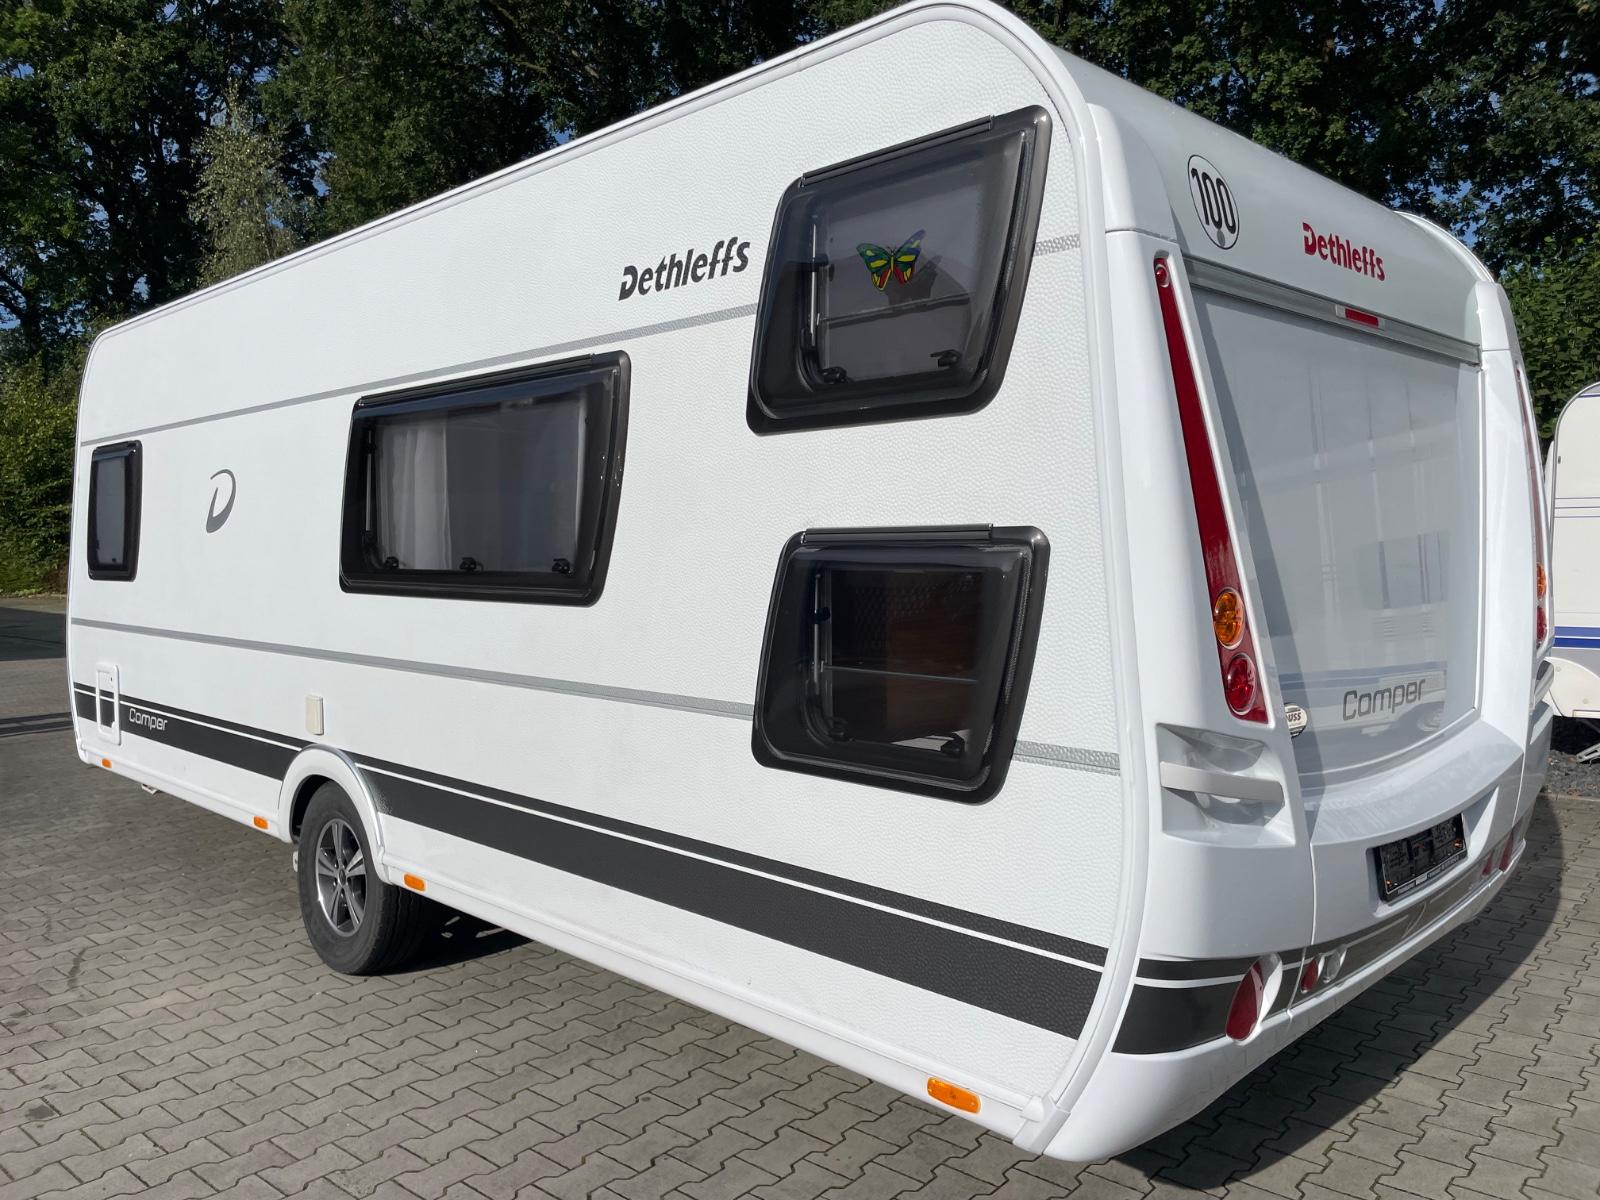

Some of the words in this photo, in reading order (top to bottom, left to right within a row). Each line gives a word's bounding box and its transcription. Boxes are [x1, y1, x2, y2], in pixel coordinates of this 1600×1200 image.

[1190, 167, 1237, 235] 100
[618, 236, 751, 301] Dethleffs
[1302, 221, 1386, 282] Dethleffs
